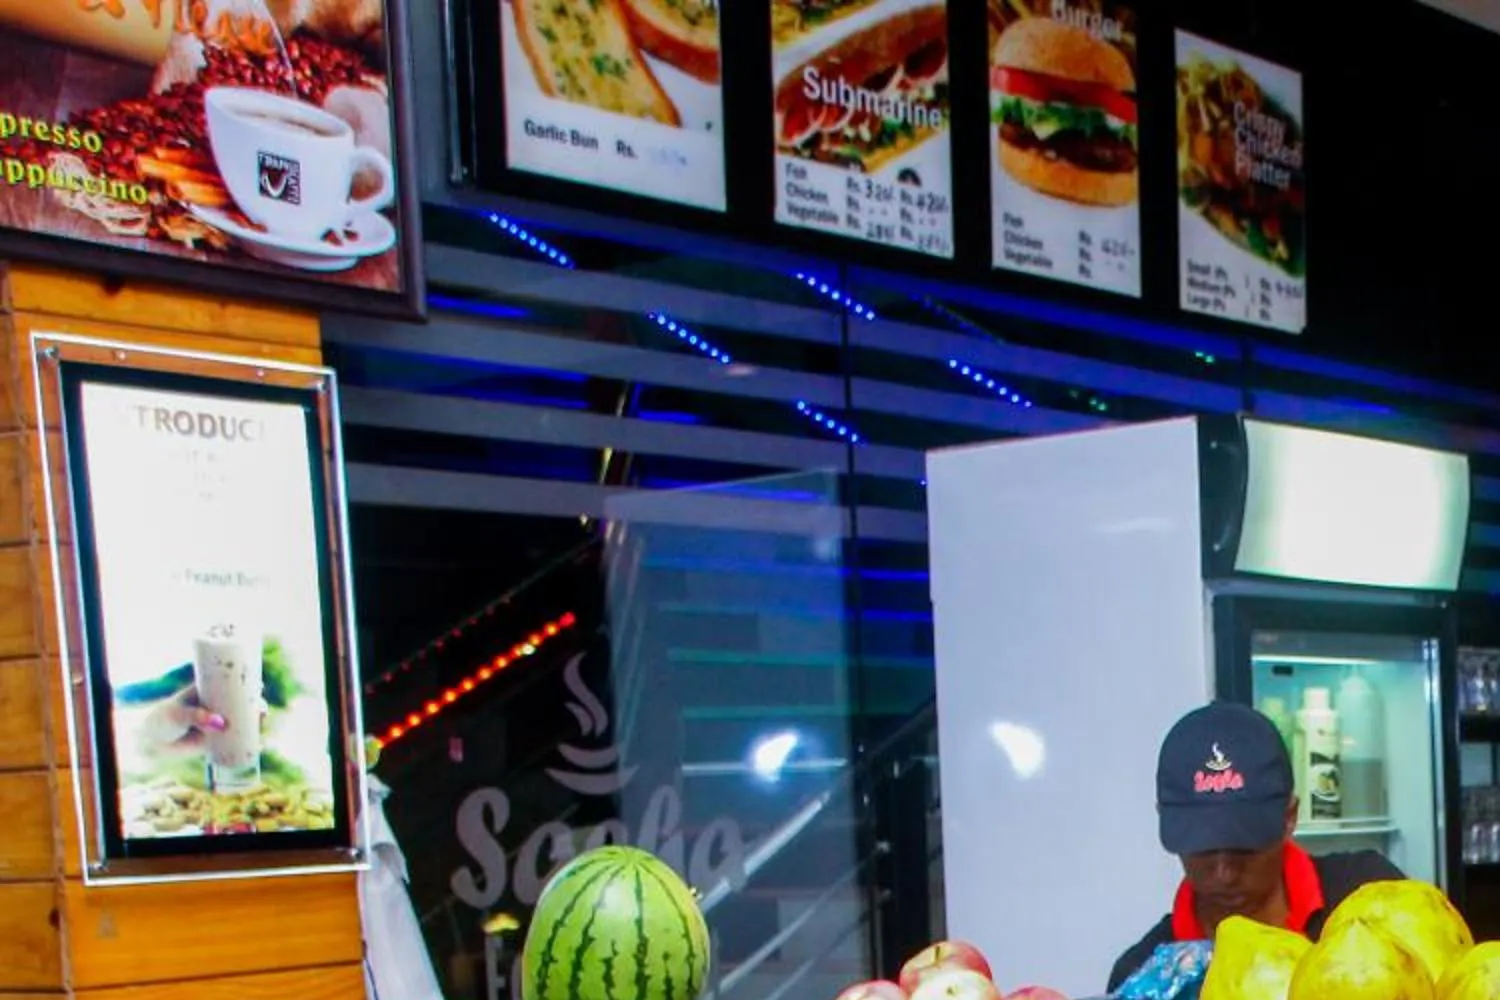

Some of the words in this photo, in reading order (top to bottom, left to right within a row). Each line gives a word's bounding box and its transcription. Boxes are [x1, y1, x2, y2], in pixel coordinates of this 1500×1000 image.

[803, 66, 942, 128] Submarine
[524, 118, 568, 144] Garlic
[571, 129, 599, 151] Bun
[0, 158, 148, 204] ppuccino
